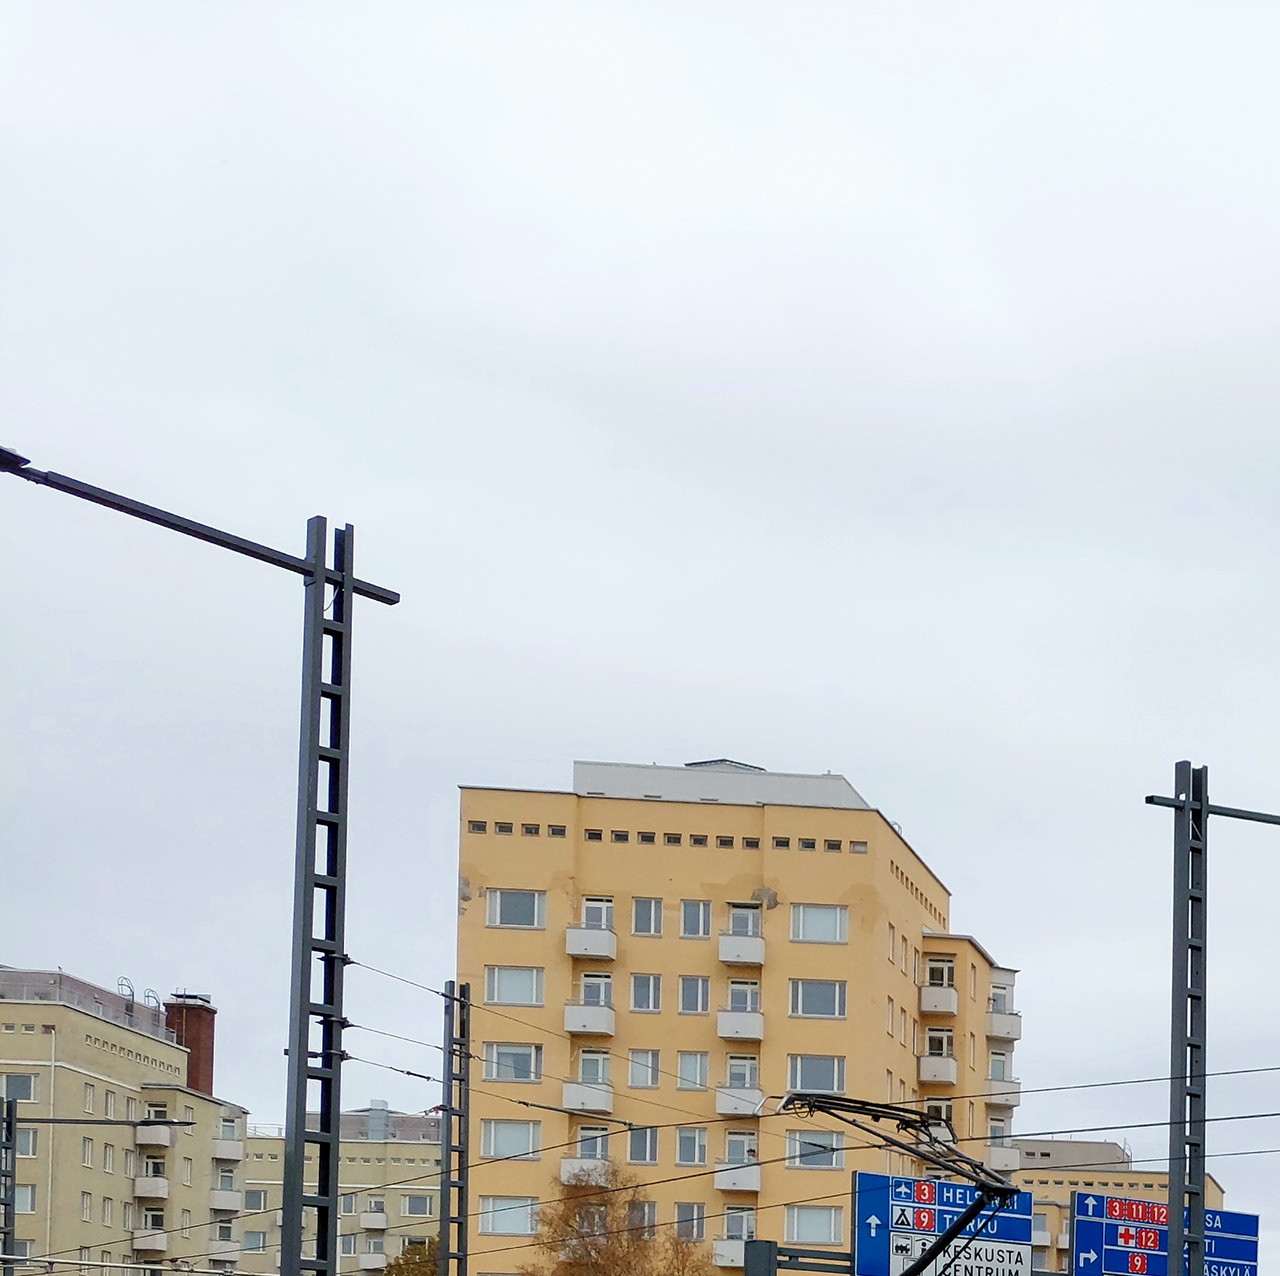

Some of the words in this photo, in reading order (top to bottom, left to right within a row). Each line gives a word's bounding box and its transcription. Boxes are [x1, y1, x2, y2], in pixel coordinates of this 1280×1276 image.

[920, 1185, 929, 1200] 3
[1112, 1202, 1120, 1216] 3
[1131, 1204, 1143, 1218] 11
[1153, 1207, 1167, 1221] 12
[920, 1212, 929, 1227] 9
[943, 1214, 998, 1234] TRKU
[1141, 1231, 1155, 1246] 12
[942, 1244, 1024, 1266] KESKUSTA
[1134, 1257, 1142, 1270] 9
